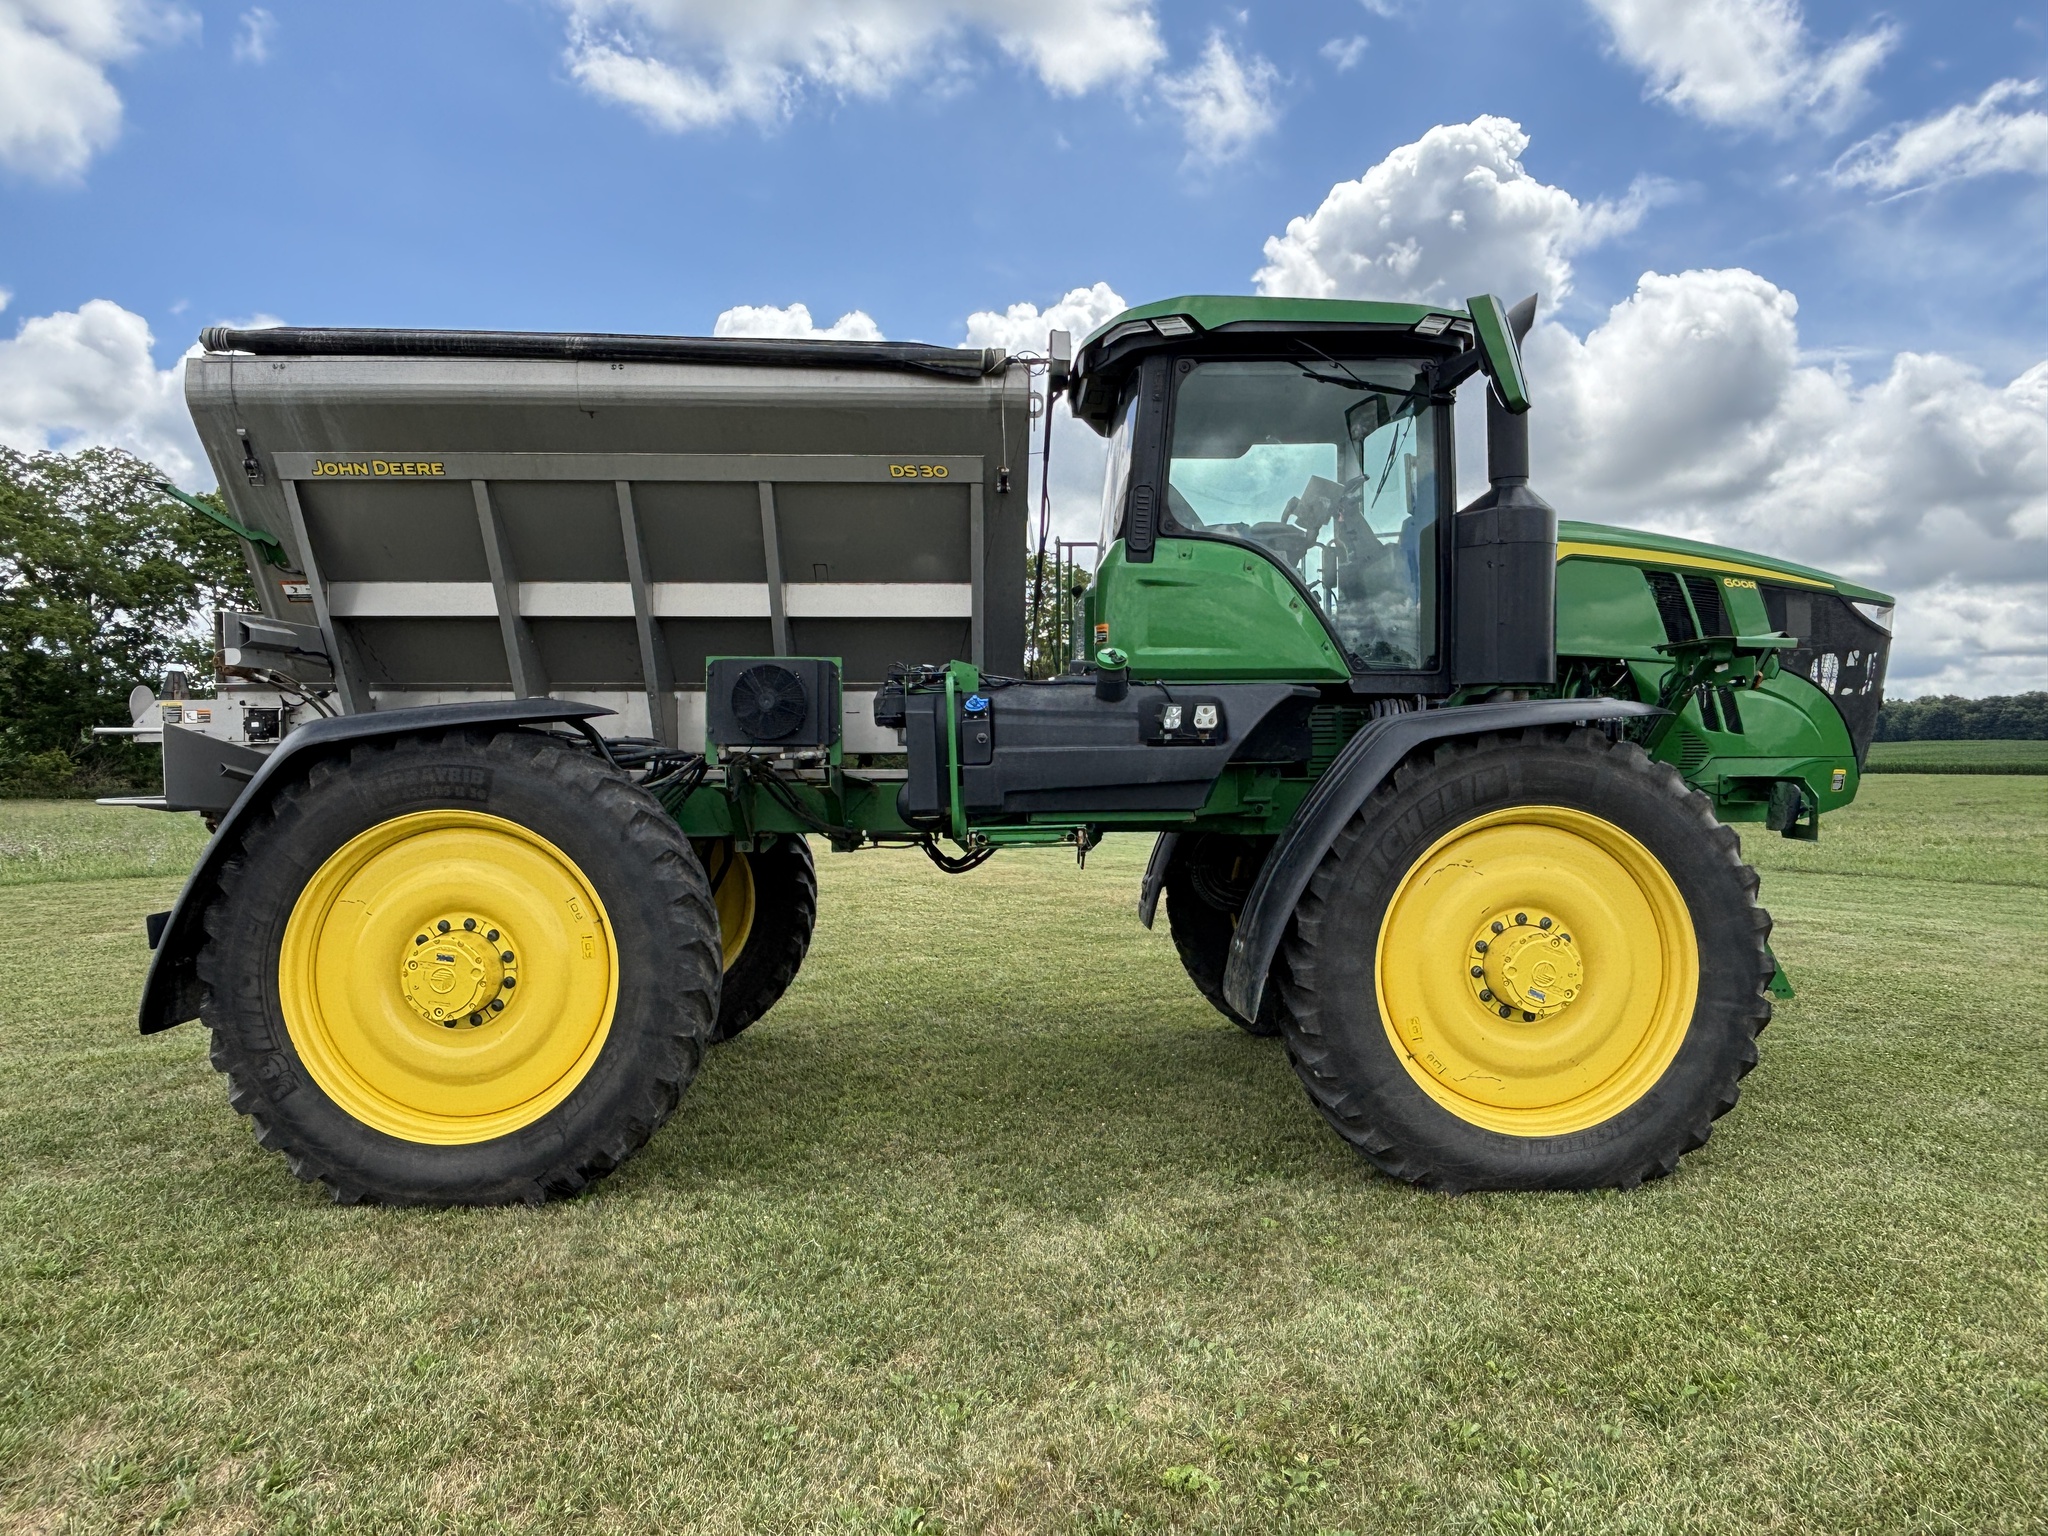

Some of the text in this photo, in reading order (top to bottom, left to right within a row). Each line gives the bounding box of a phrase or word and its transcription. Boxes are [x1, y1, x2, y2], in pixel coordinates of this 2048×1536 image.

[312, 459, 445, 476] JOHN DEERE
[1723, 578, 1757, 589] 600R
